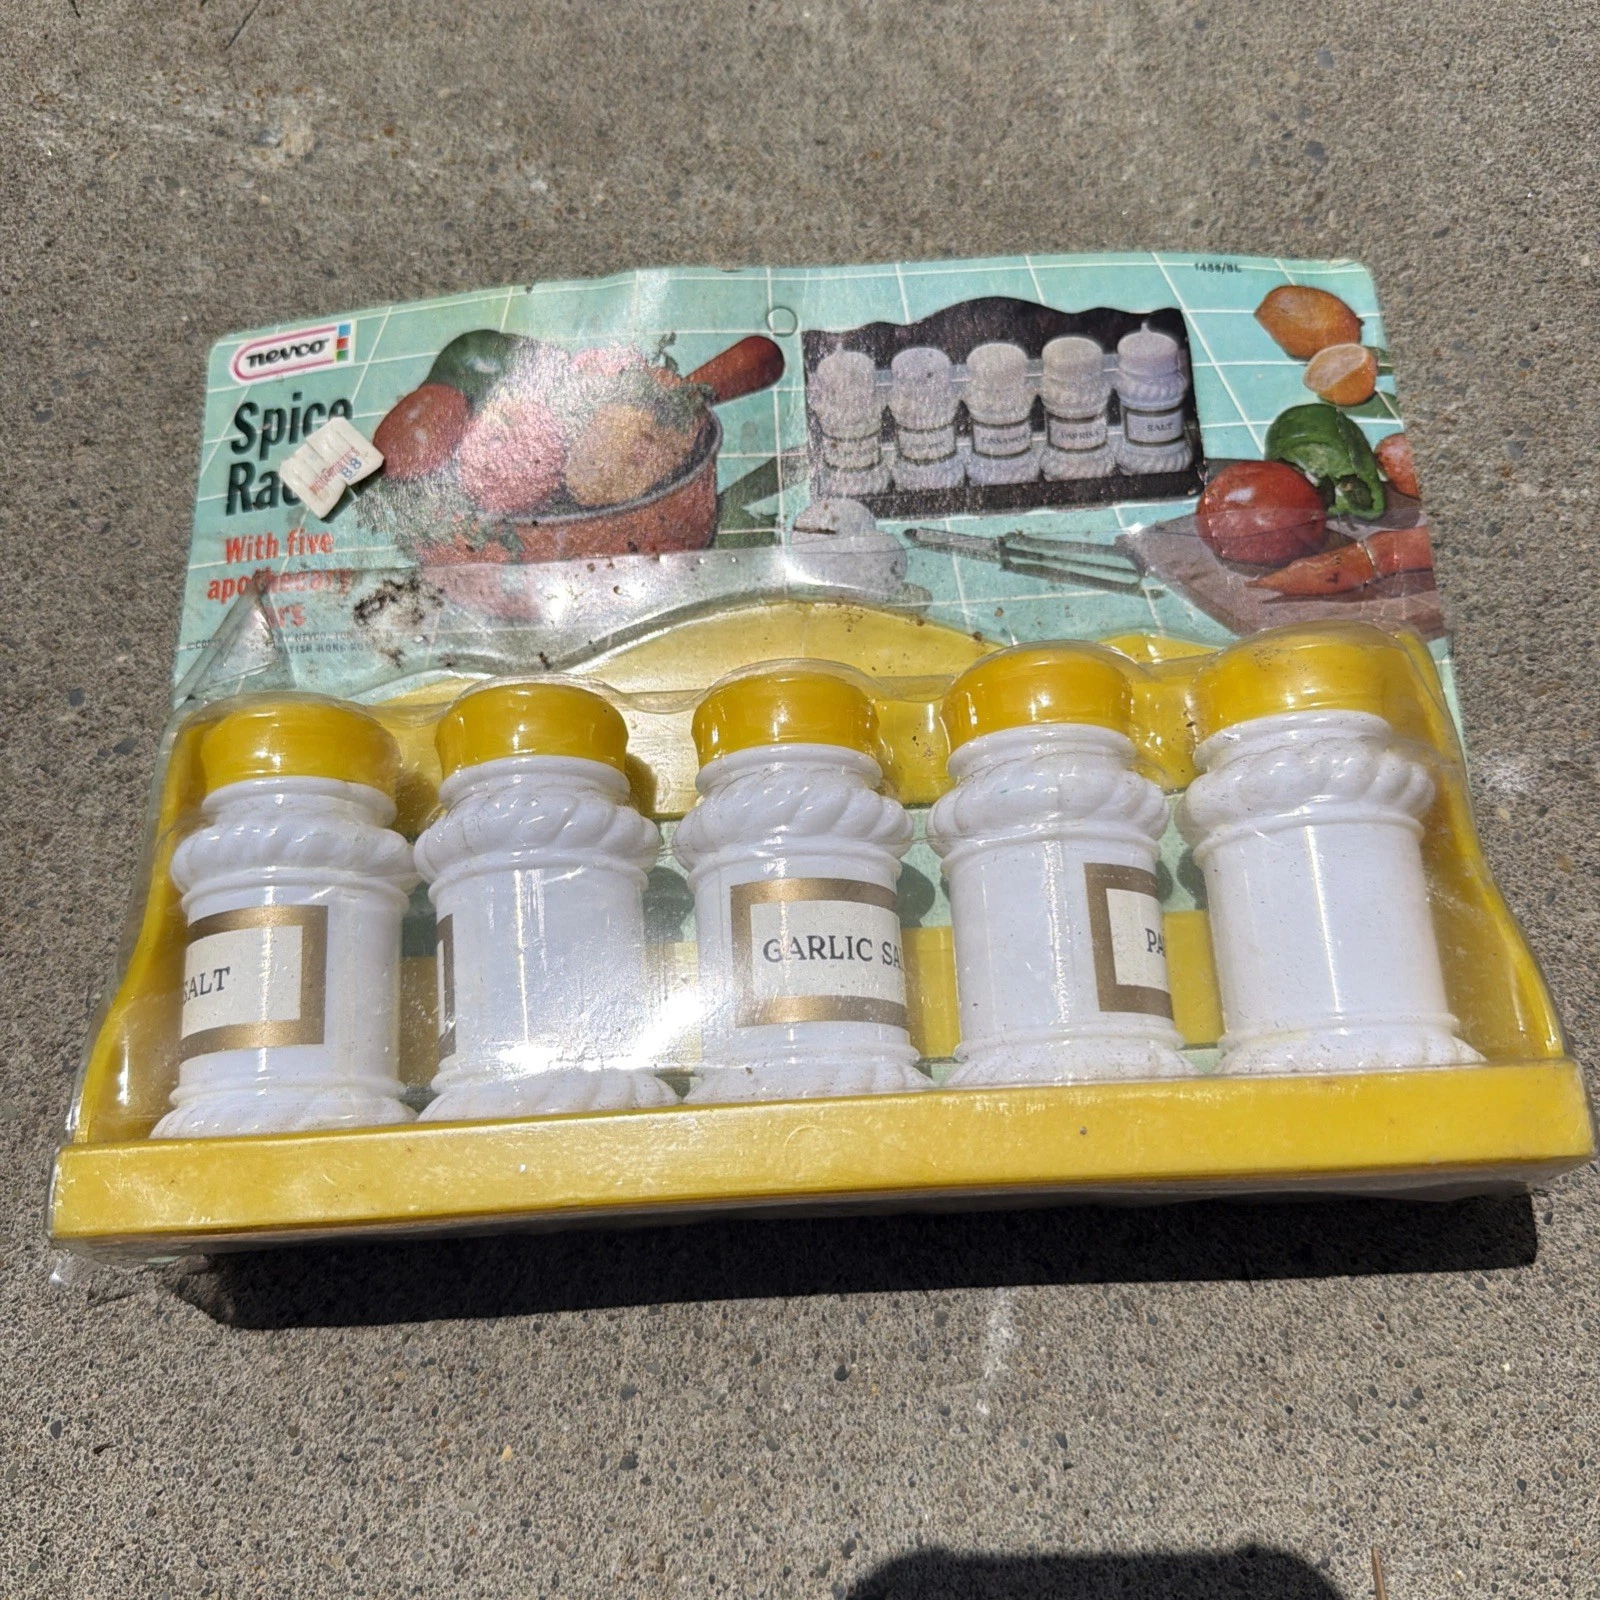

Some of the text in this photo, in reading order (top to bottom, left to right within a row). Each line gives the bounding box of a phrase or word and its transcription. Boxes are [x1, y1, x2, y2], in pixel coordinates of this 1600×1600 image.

[247, 338, 329, 369] nevco
[225, 462, 301, 516] Ra
[225, 528, 334, 564] With five
[763, 935, 904, 969] GARLIC SA
